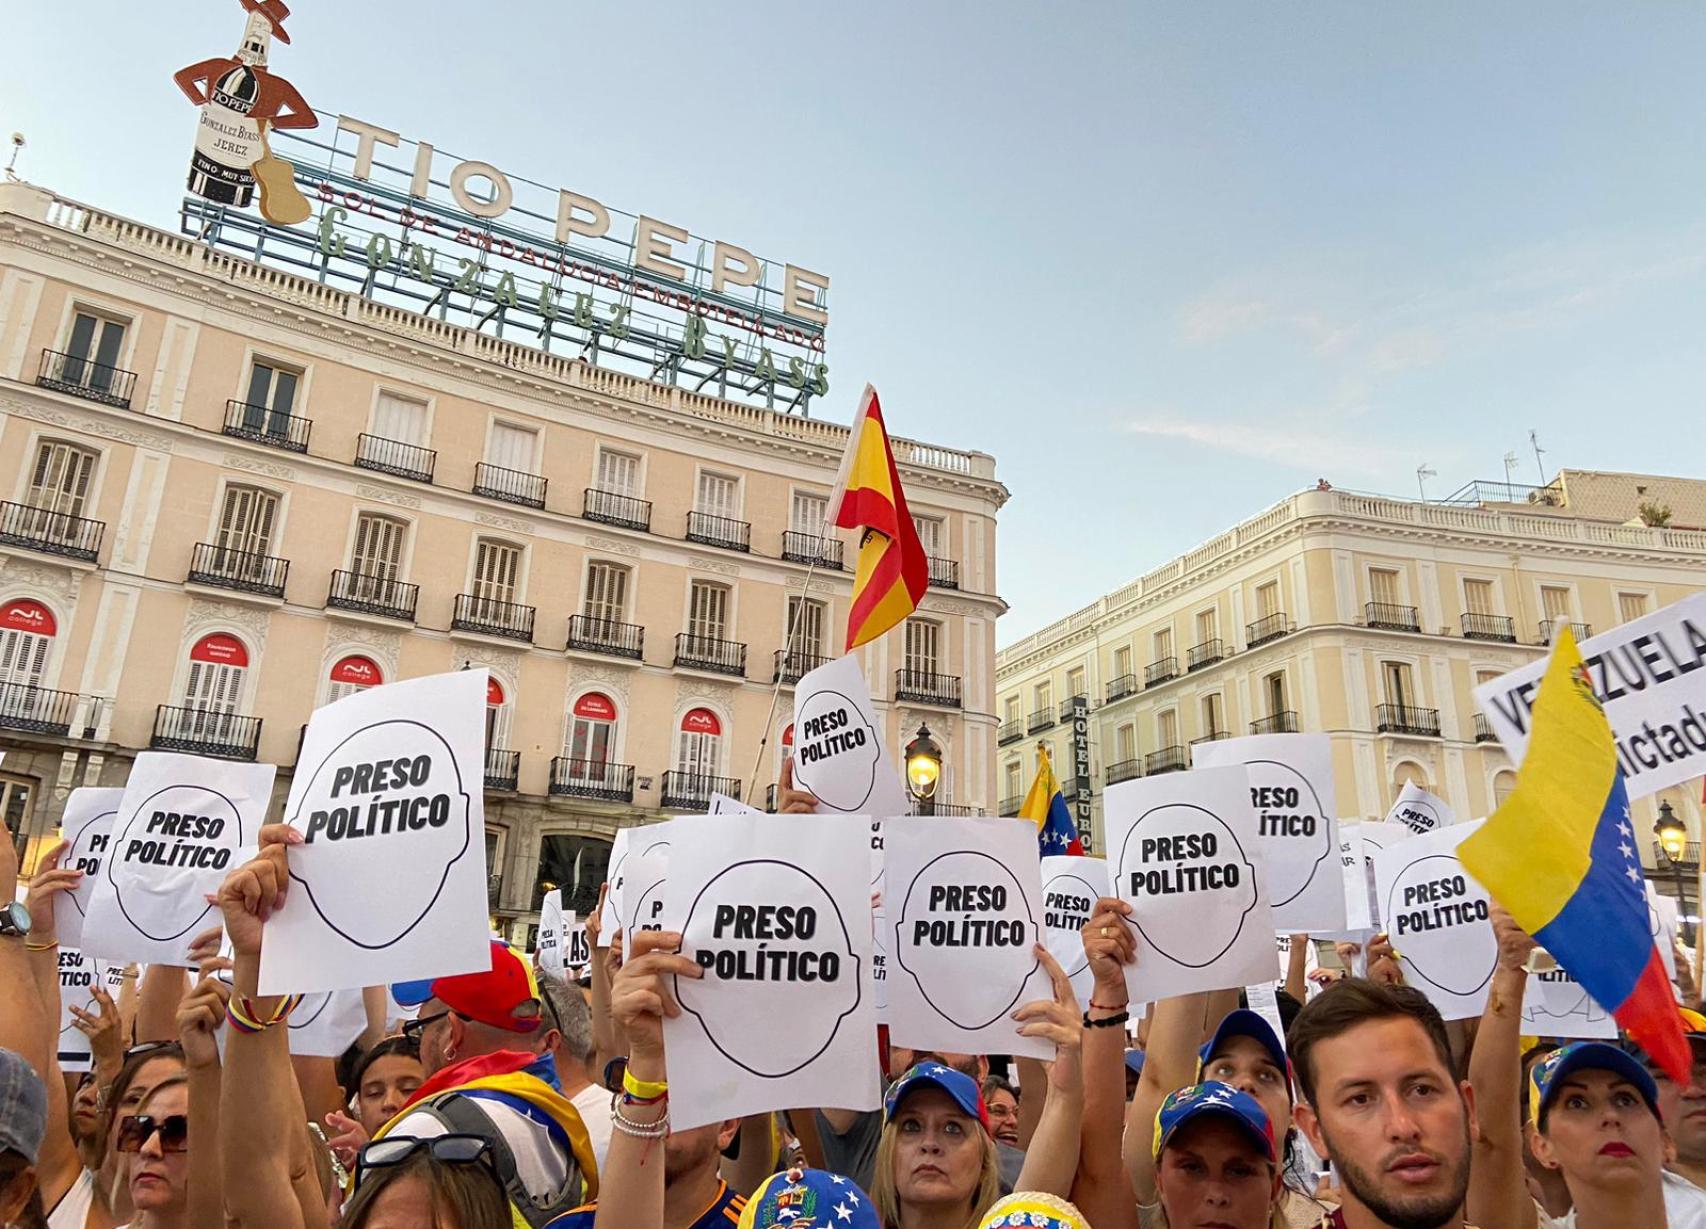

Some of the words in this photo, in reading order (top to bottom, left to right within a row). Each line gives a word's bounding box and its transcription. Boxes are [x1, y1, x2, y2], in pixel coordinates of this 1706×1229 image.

[213, 139, 248, 156] JEREZ
[318, 184, 386, 221] SOL
[400, 208, 440, 235] DE
[337, 114, 513, 219] TIO
[555, 188, 830, 327] PEPE
[319, 207, 631, 338] GONZALEZ
[684, 313, 829, 397] BYASS
[1490, 618, 1706, 735] VEZUELA
[804, 708, 848, 740] PRESO
[1074, 706, 1089, 777] HOTEL
[1612, 704, 1706, 778] ictad
[800, 728, 867, 766] POLÍTICO
[330, 754, 432, 799] PRESO
[146, 811, 225, 840] PRESO
[305, 794, 450, 843] POLÍTICO
[1078, 789, 1092, 856] EURO
[1402, 808, 1435, 828] PRESO
[124, 838, 231, 870] POLÍTICO
[1142, 833, 1217, 863] PRESO
[1131, 863, 1239, 897] POLÍTICO
[1404, 874, 1466, 907] PRESO
[929, 885, 1007, 912] PRESO
[1045, 892, 1091, 913] PRESO
[713, 904, 816, 940] PRESO
[913, 914, 1025, 947] POLÍTICO
[1397, 899, 1490, 935] POLÍTICO
[57, 952, 83, 967] ESO
[696, 942, 840, 982] POLÍTICO
